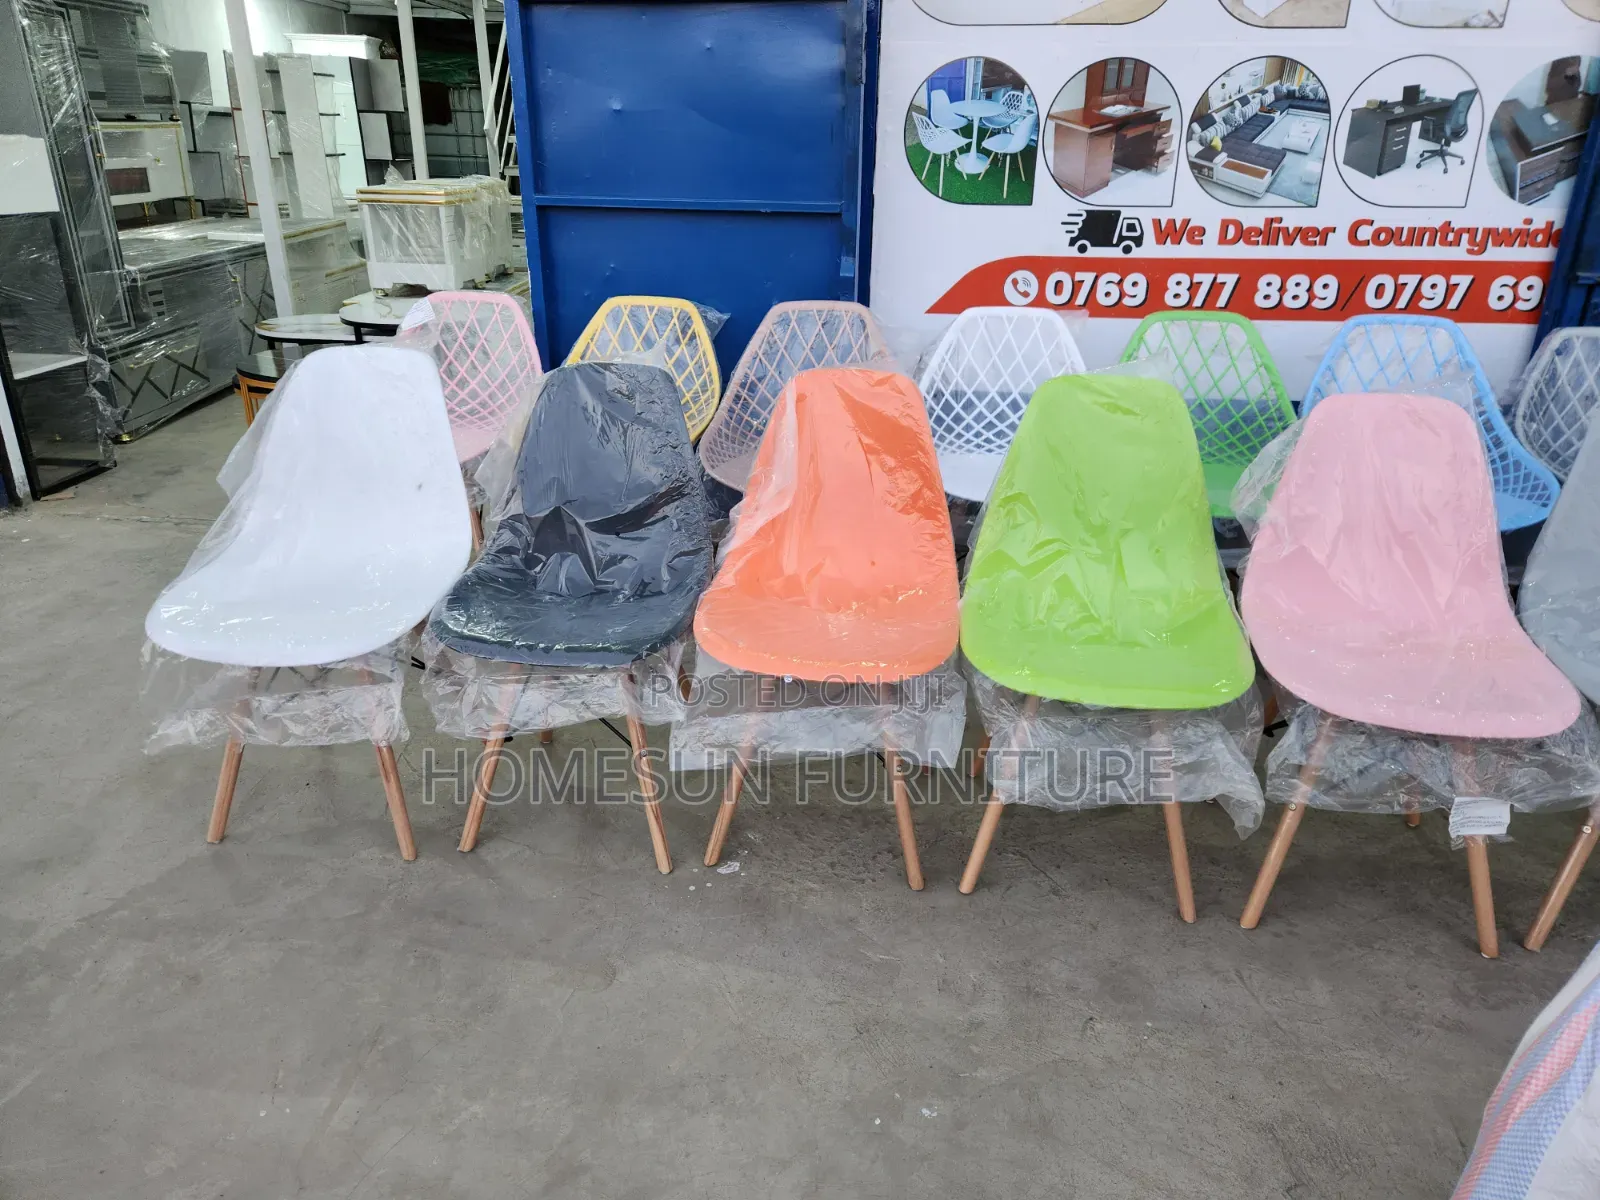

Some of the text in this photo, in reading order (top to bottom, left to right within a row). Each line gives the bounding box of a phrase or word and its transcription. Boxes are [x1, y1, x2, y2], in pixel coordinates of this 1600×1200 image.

[1152, 218, 1206, 246] We
[1217, 217, 1336, 247] Deliver
[1045, 271, 1149, 307] 0769
[1164, 272, 1240, 309] 877
[1487, 275, 1545, 312] 69
